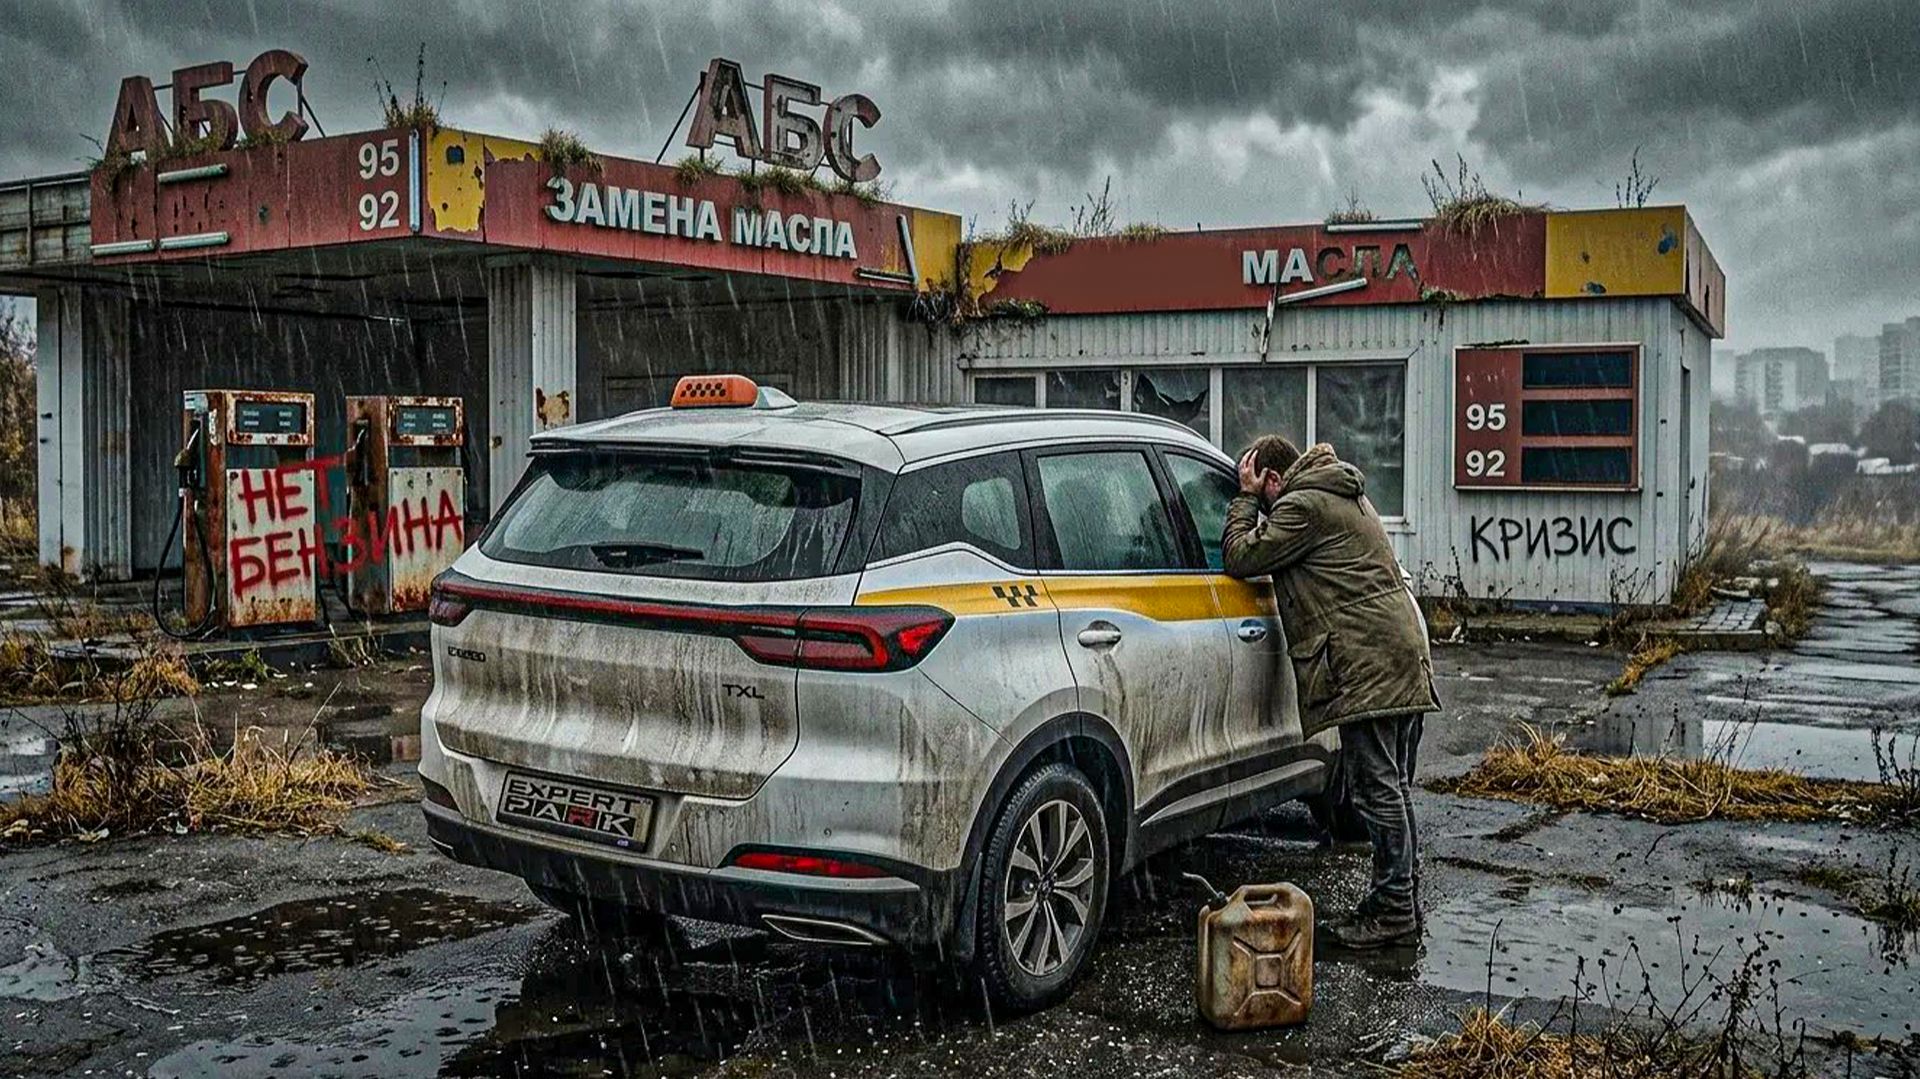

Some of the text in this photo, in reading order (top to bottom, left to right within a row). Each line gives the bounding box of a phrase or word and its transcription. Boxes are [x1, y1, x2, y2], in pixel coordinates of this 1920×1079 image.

[104, 50, 309, 164] АБС
[686, 58, 882, 182] АБС
[358, 139, 399, 180] 95
[358, 190, 400, 231] 92
[546, 176, 858, 259] ЗАМЕНА МАСЛА
[1466, 403, 1507, 431] 95
[1465, 450, 1506, 477] 92
[237, 455, 346, 525] НЕТ
[230, 489, 463, 600] БЕНЗИНА
[1470, 515, 1637, 563] КРИЗИС
[722, 684, 765, 699] TXL
[507, 796, 632, 836] PARK
[508, 780, 642, 814] EXPERT
